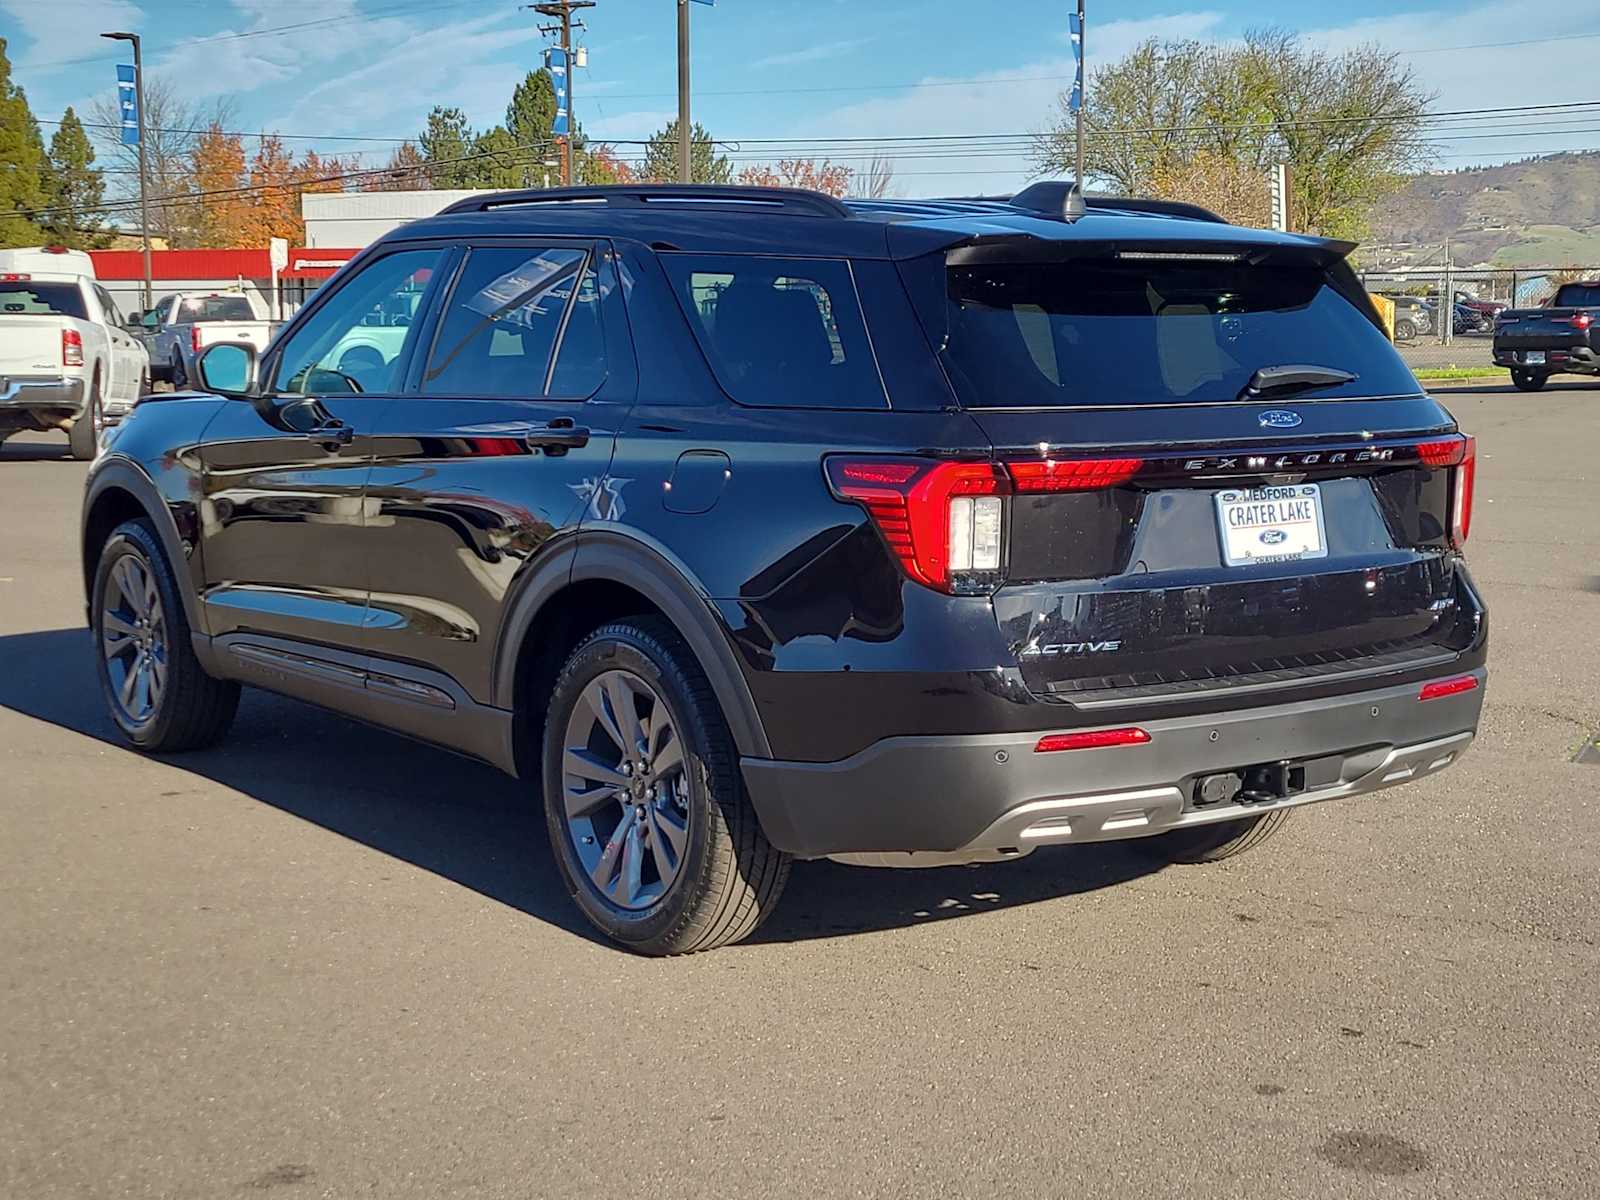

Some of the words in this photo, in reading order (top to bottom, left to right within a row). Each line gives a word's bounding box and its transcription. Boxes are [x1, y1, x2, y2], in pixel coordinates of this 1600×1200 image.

[1243, 488, 1296, 502] MEDFORD
[1228, 504, 1277, 526] CRATER
[1279, 501, 1312, 522] LAKE
[1022, 640, 1122, 656] ACTIVE
